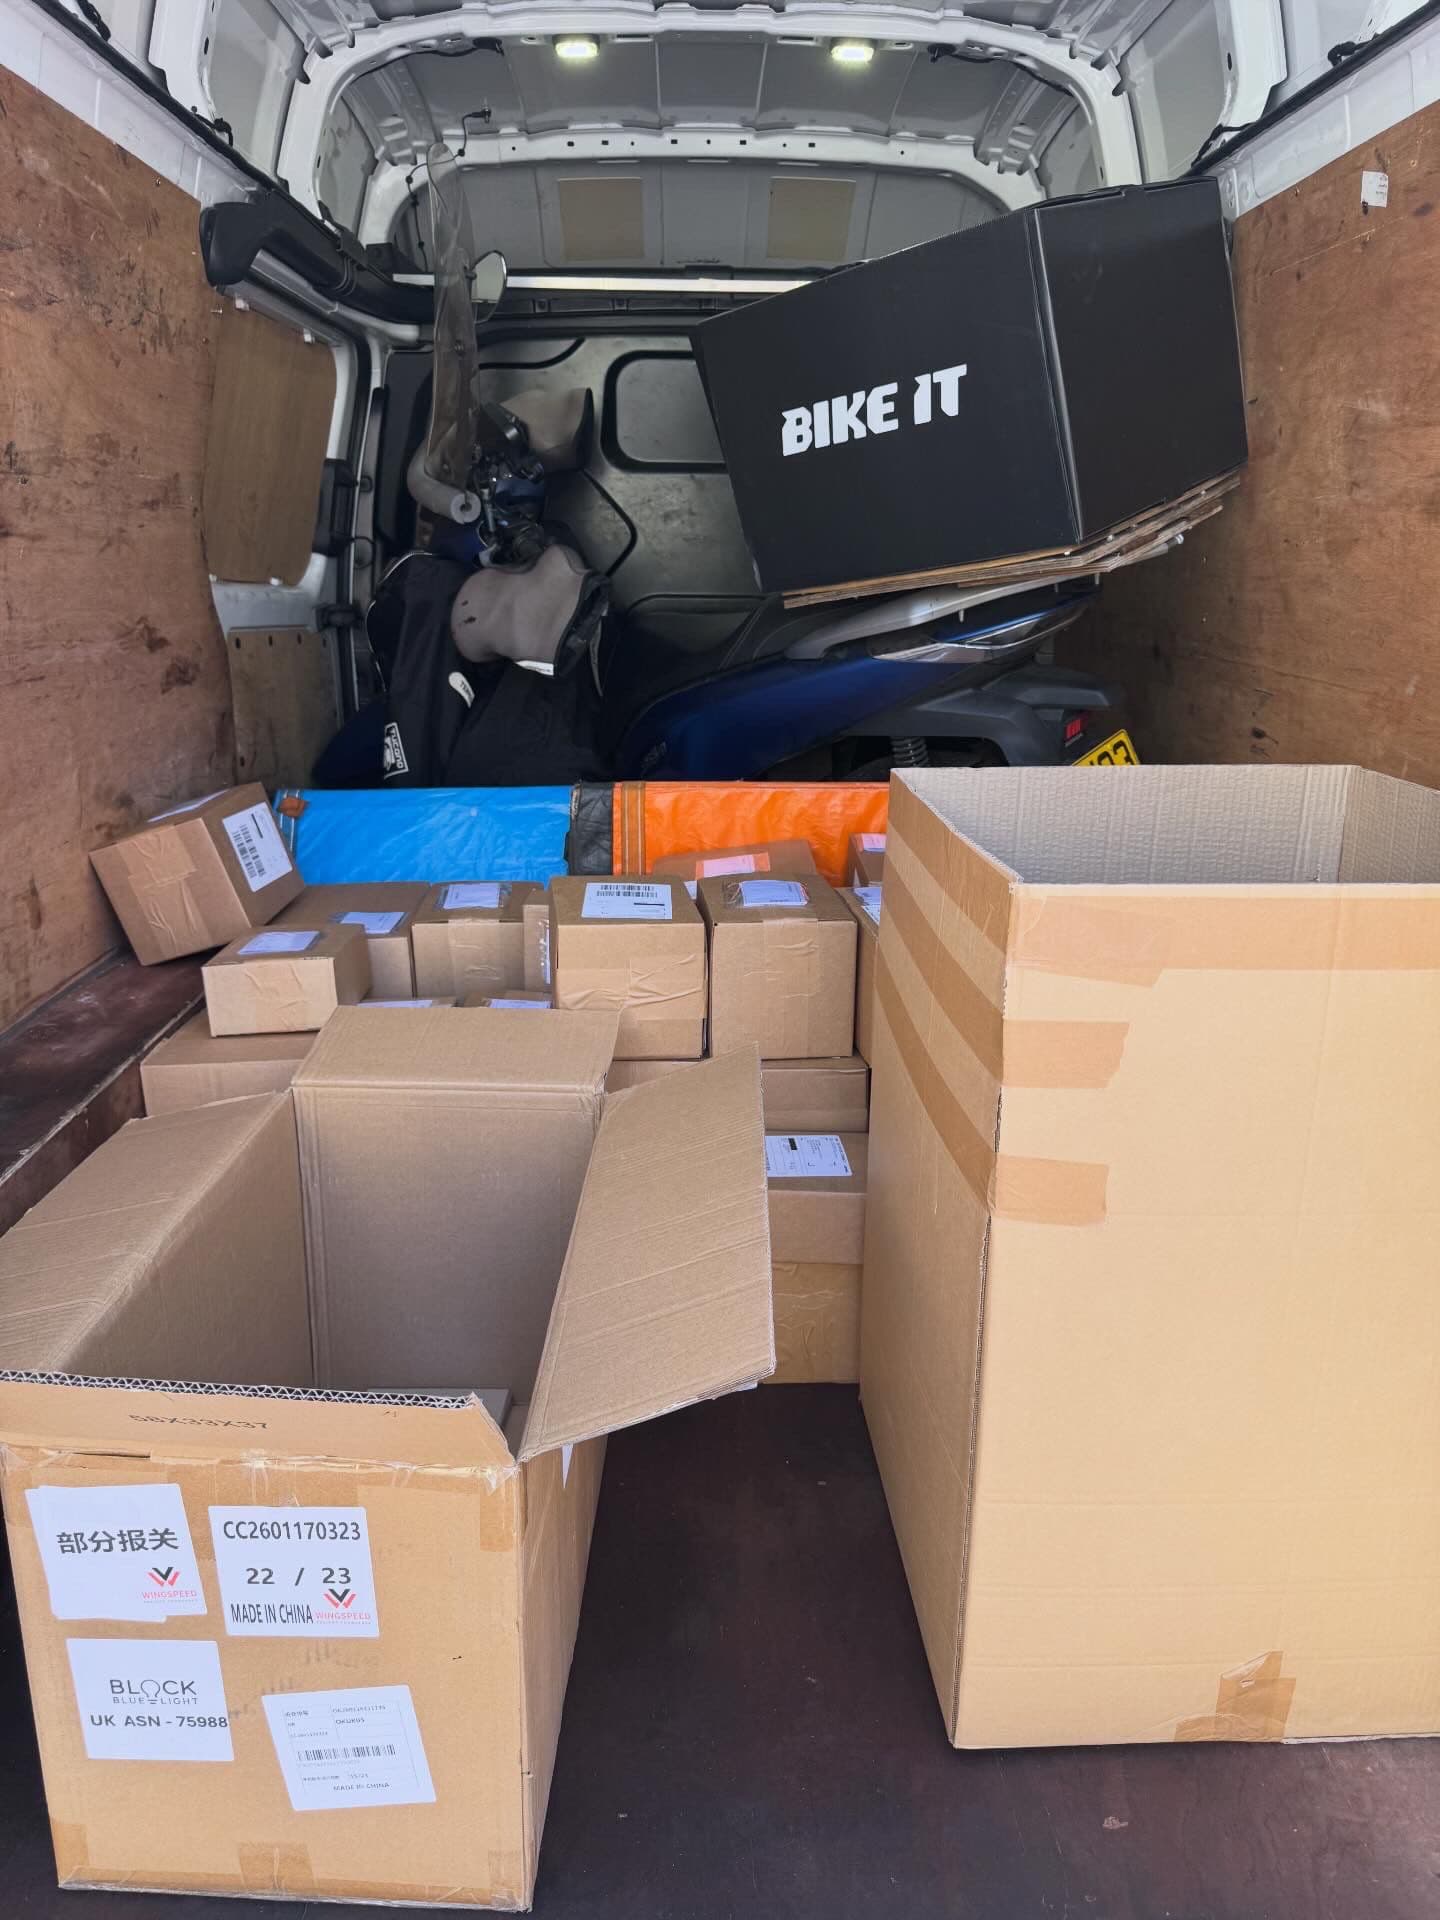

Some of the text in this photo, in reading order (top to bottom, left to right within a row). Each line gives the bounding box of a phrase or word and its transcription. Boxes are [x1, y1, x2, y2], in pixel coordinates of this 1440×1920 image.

[782, 363, 967, 456] BIKE IT
[223, 1520, 361, 1540] CC2601170323
[56, 1528, 179, 1554] 部分报关
[246, 1567, 352, 1587] 22 / 23
[141, 1590, 197, 1599] WINGSPEED
[231, 1604, 314, 1624] MADE IN CHINA
[314, 1611, 371, 1620] WINGSPEED
[109, 1679, 197, 1697] BLOCK
[112, 1696, 198, 1705] BLUE LIGHT
[90, 1715, 116, 1726] UK
[124, 1715, 161, 1727] ASN
[175, 1716, 229, 1728] 75988
